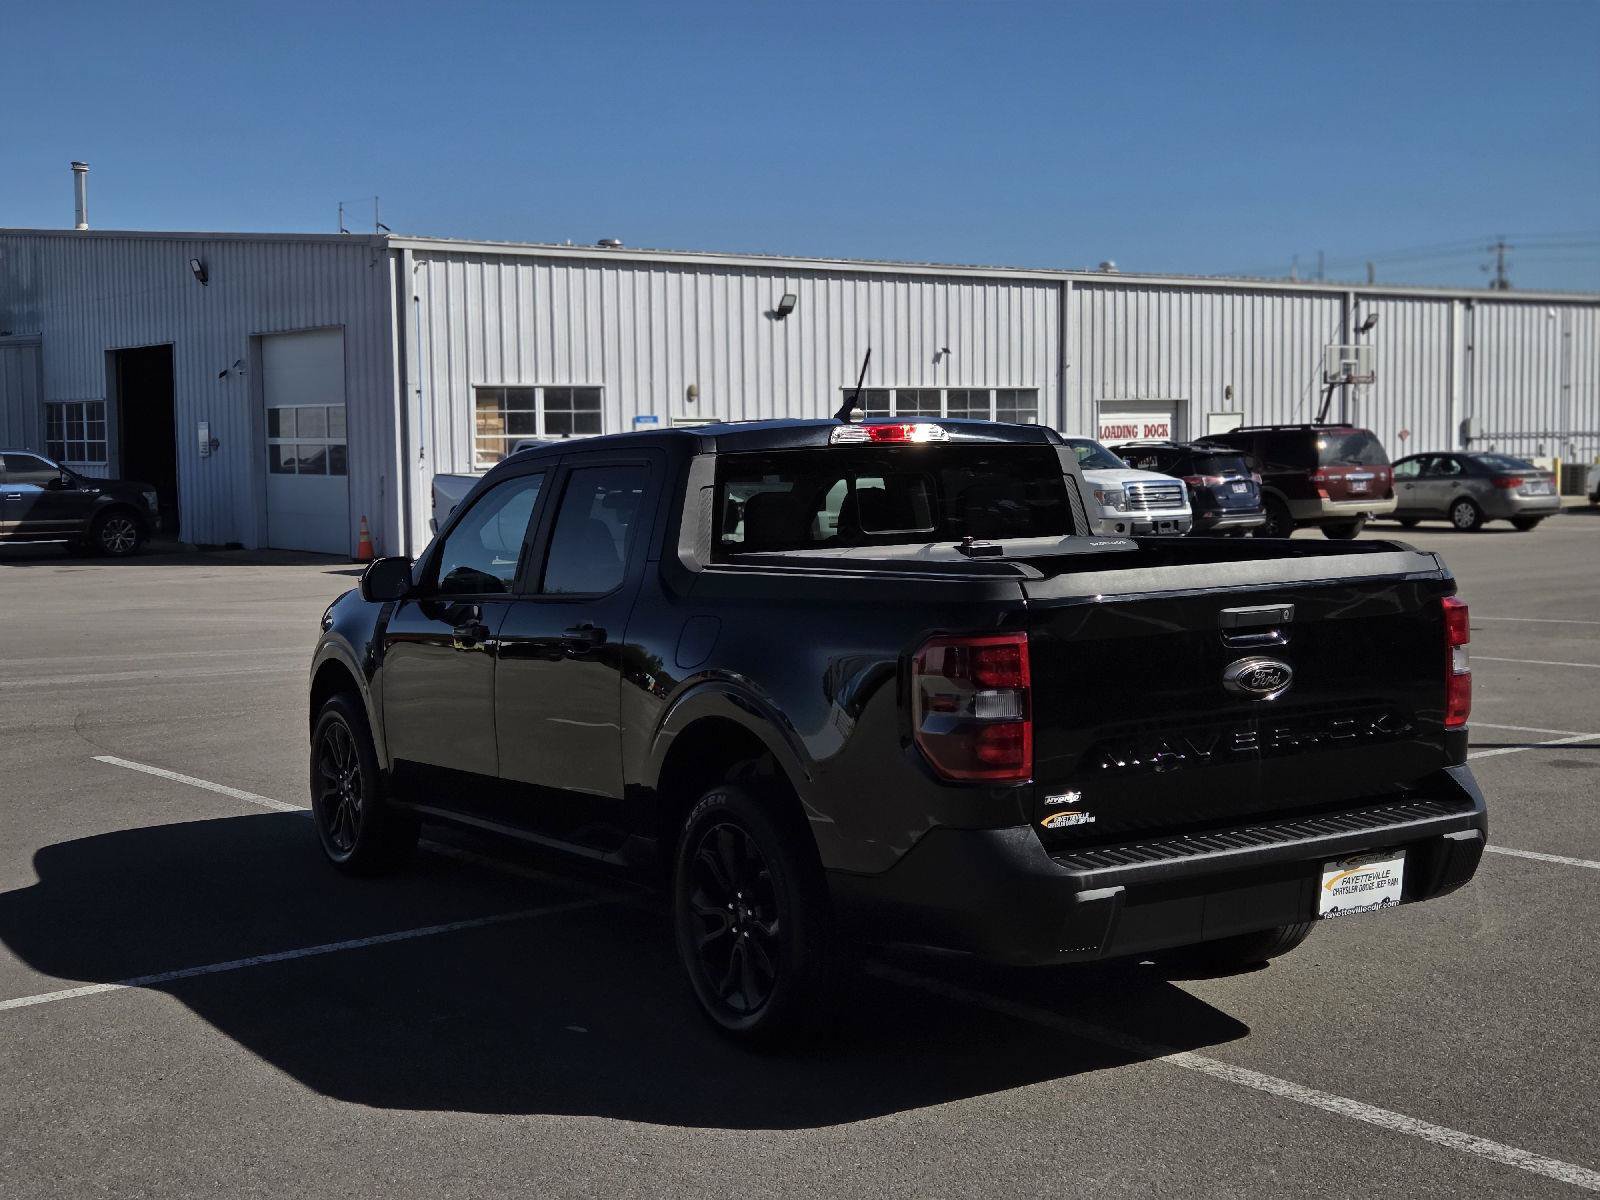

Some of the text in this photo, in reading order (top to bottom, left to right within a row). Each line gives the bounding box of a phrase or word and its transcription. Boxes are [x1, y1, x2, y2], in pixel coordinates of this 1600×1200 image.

[1099, 423, 1169, 439] LOADING DOCK
[1251, 668, 1281, 687] Ford
[1332, 877, 1399, 896] CHRYSLER DODGE JEEP RAM
[1341, 869, 1391, 886] FAYETTEVILLE
